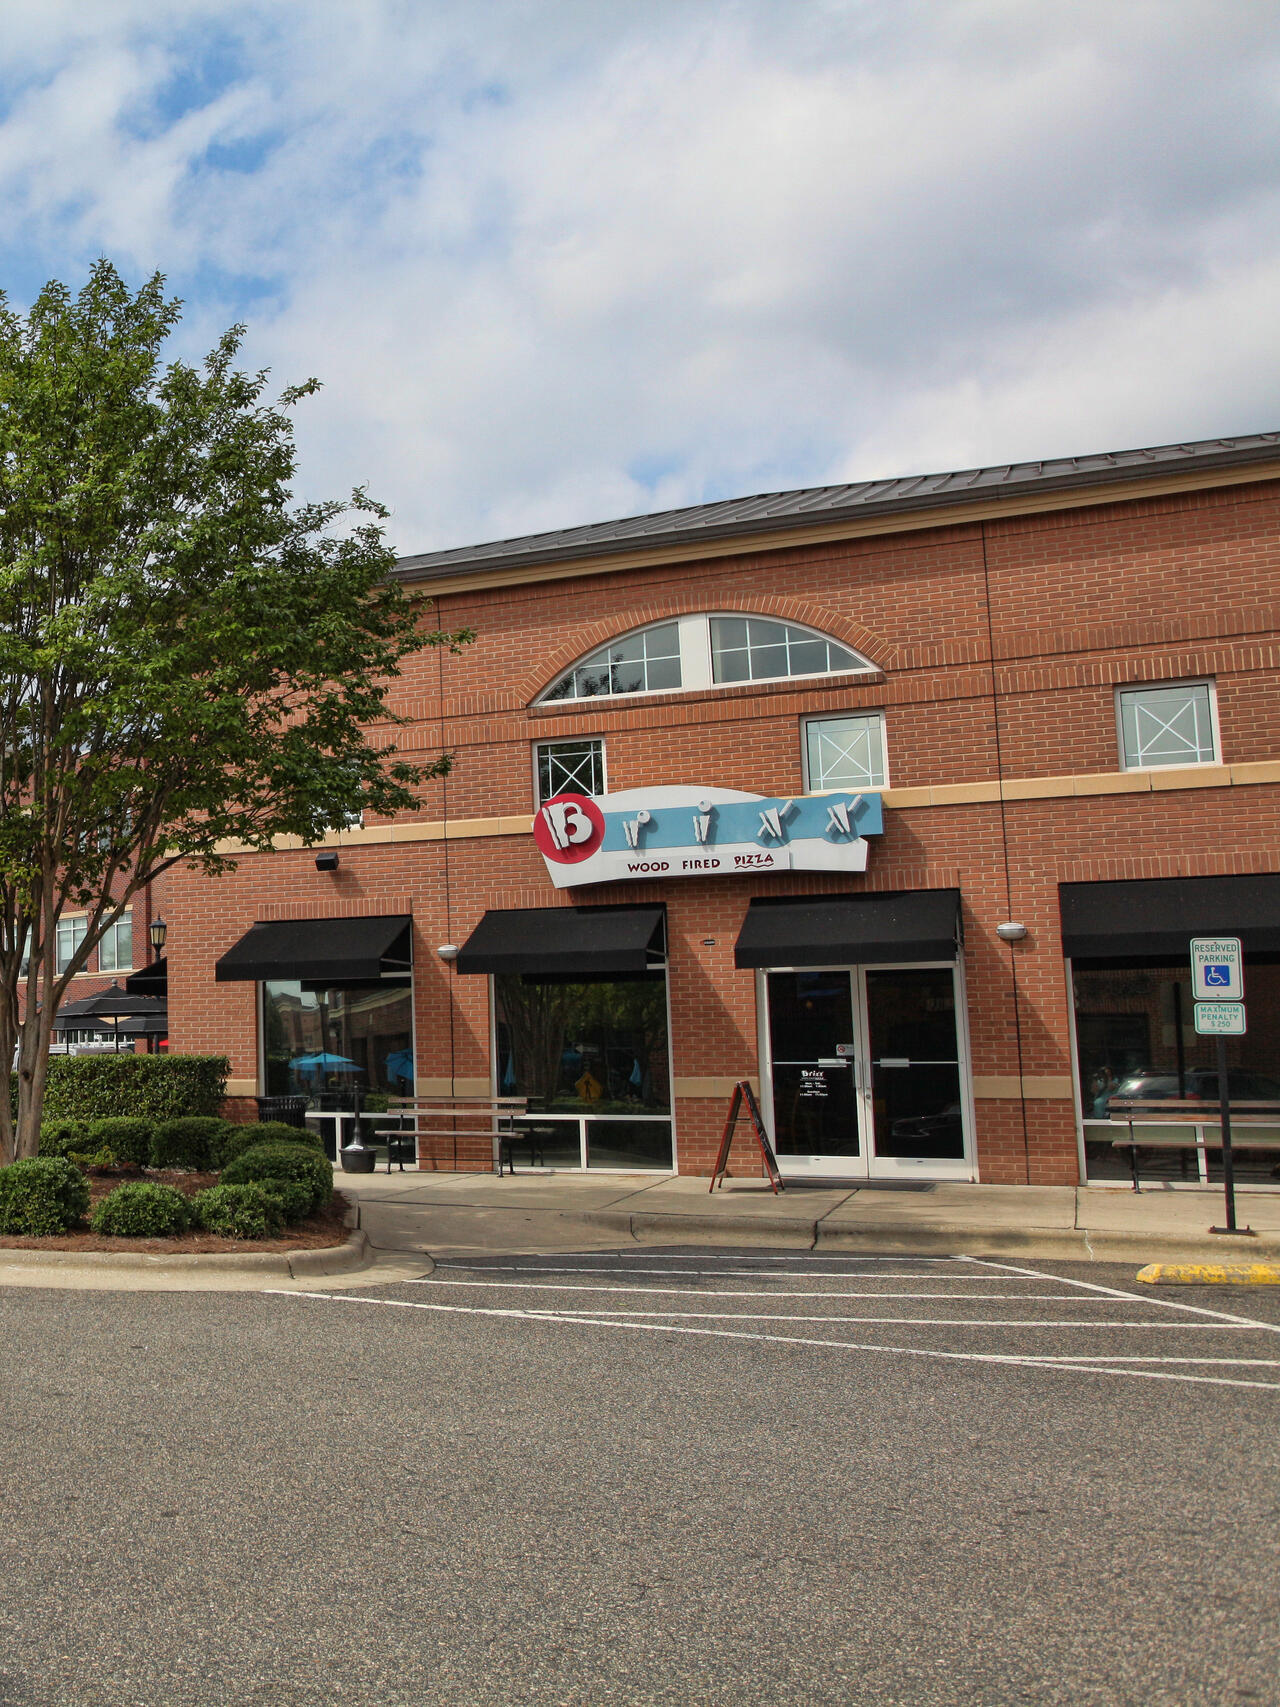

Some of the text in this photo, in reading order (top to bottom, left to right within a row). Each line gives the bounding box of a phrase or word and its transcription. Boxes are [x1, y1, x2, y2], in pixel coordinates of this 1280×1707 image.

[627, 853, 774, 873] WOOD FIRED PIZZA
[1194, 944, 1237, 953] RESERVED
[1198, 954, 1235, 963] PARKING
